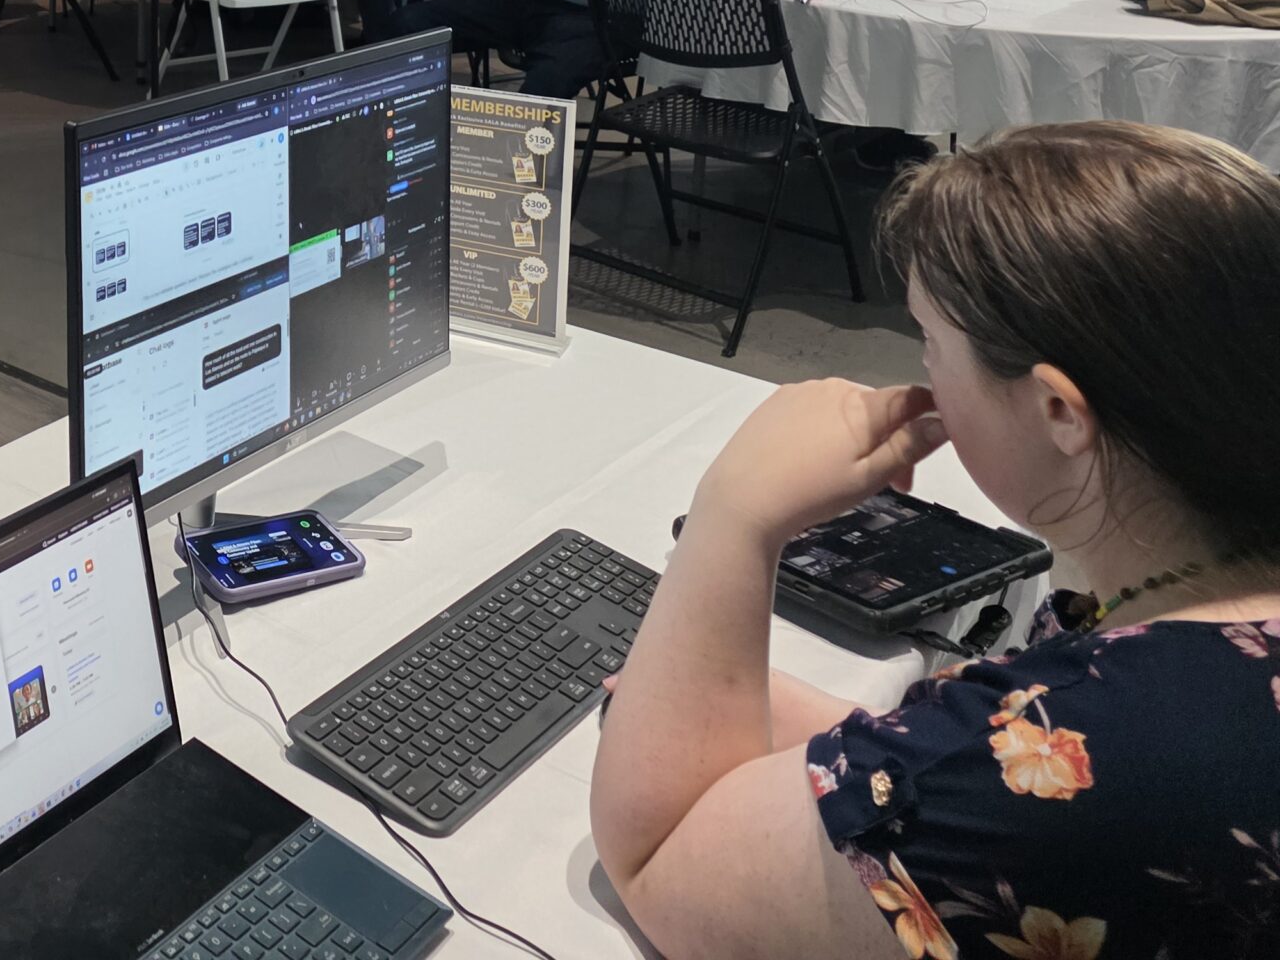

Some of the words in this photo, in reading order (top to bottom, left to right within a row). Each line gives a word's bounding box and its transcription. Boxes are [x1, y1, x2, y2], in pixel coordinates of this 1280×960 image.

[451, 96, 561, 124] MEMBERSHIPS
[457, 126, 494, 138] MEMBER
[528, 134, 552, 145] $150
[451, 184, 496, 200] UNLIMITED
[525, 199, 548, 210] $300
[463, 250, 478, 259] VIP
[523, 263, 546, 274] $600
